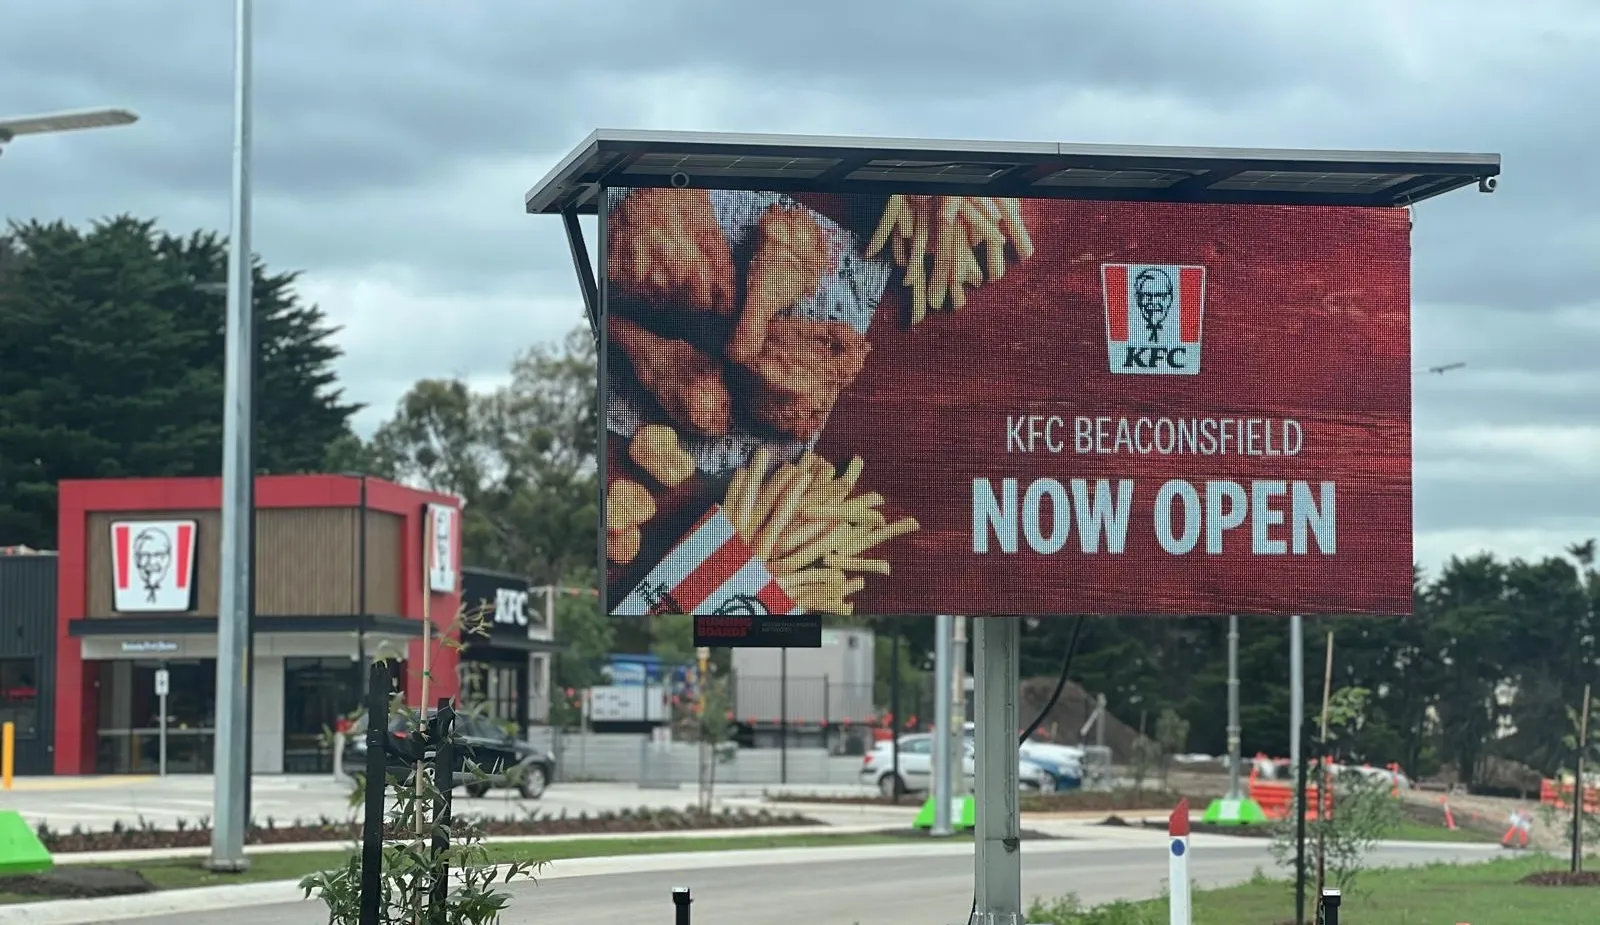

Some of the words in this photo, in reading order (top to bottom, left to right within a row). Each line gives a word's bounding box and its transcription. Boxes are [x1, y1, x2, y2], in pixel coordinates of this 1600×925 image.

[1123, 346, 1187, 369] KFC
[1006, 415, 1064, 454] KFC
[1074, 416, 1304, 457] BEACONSFIELD
[972, 477, 1135, 555] NOW
[1154, 479, 1337, 555] OPEN
[495, 588, 528, 626] KFC
